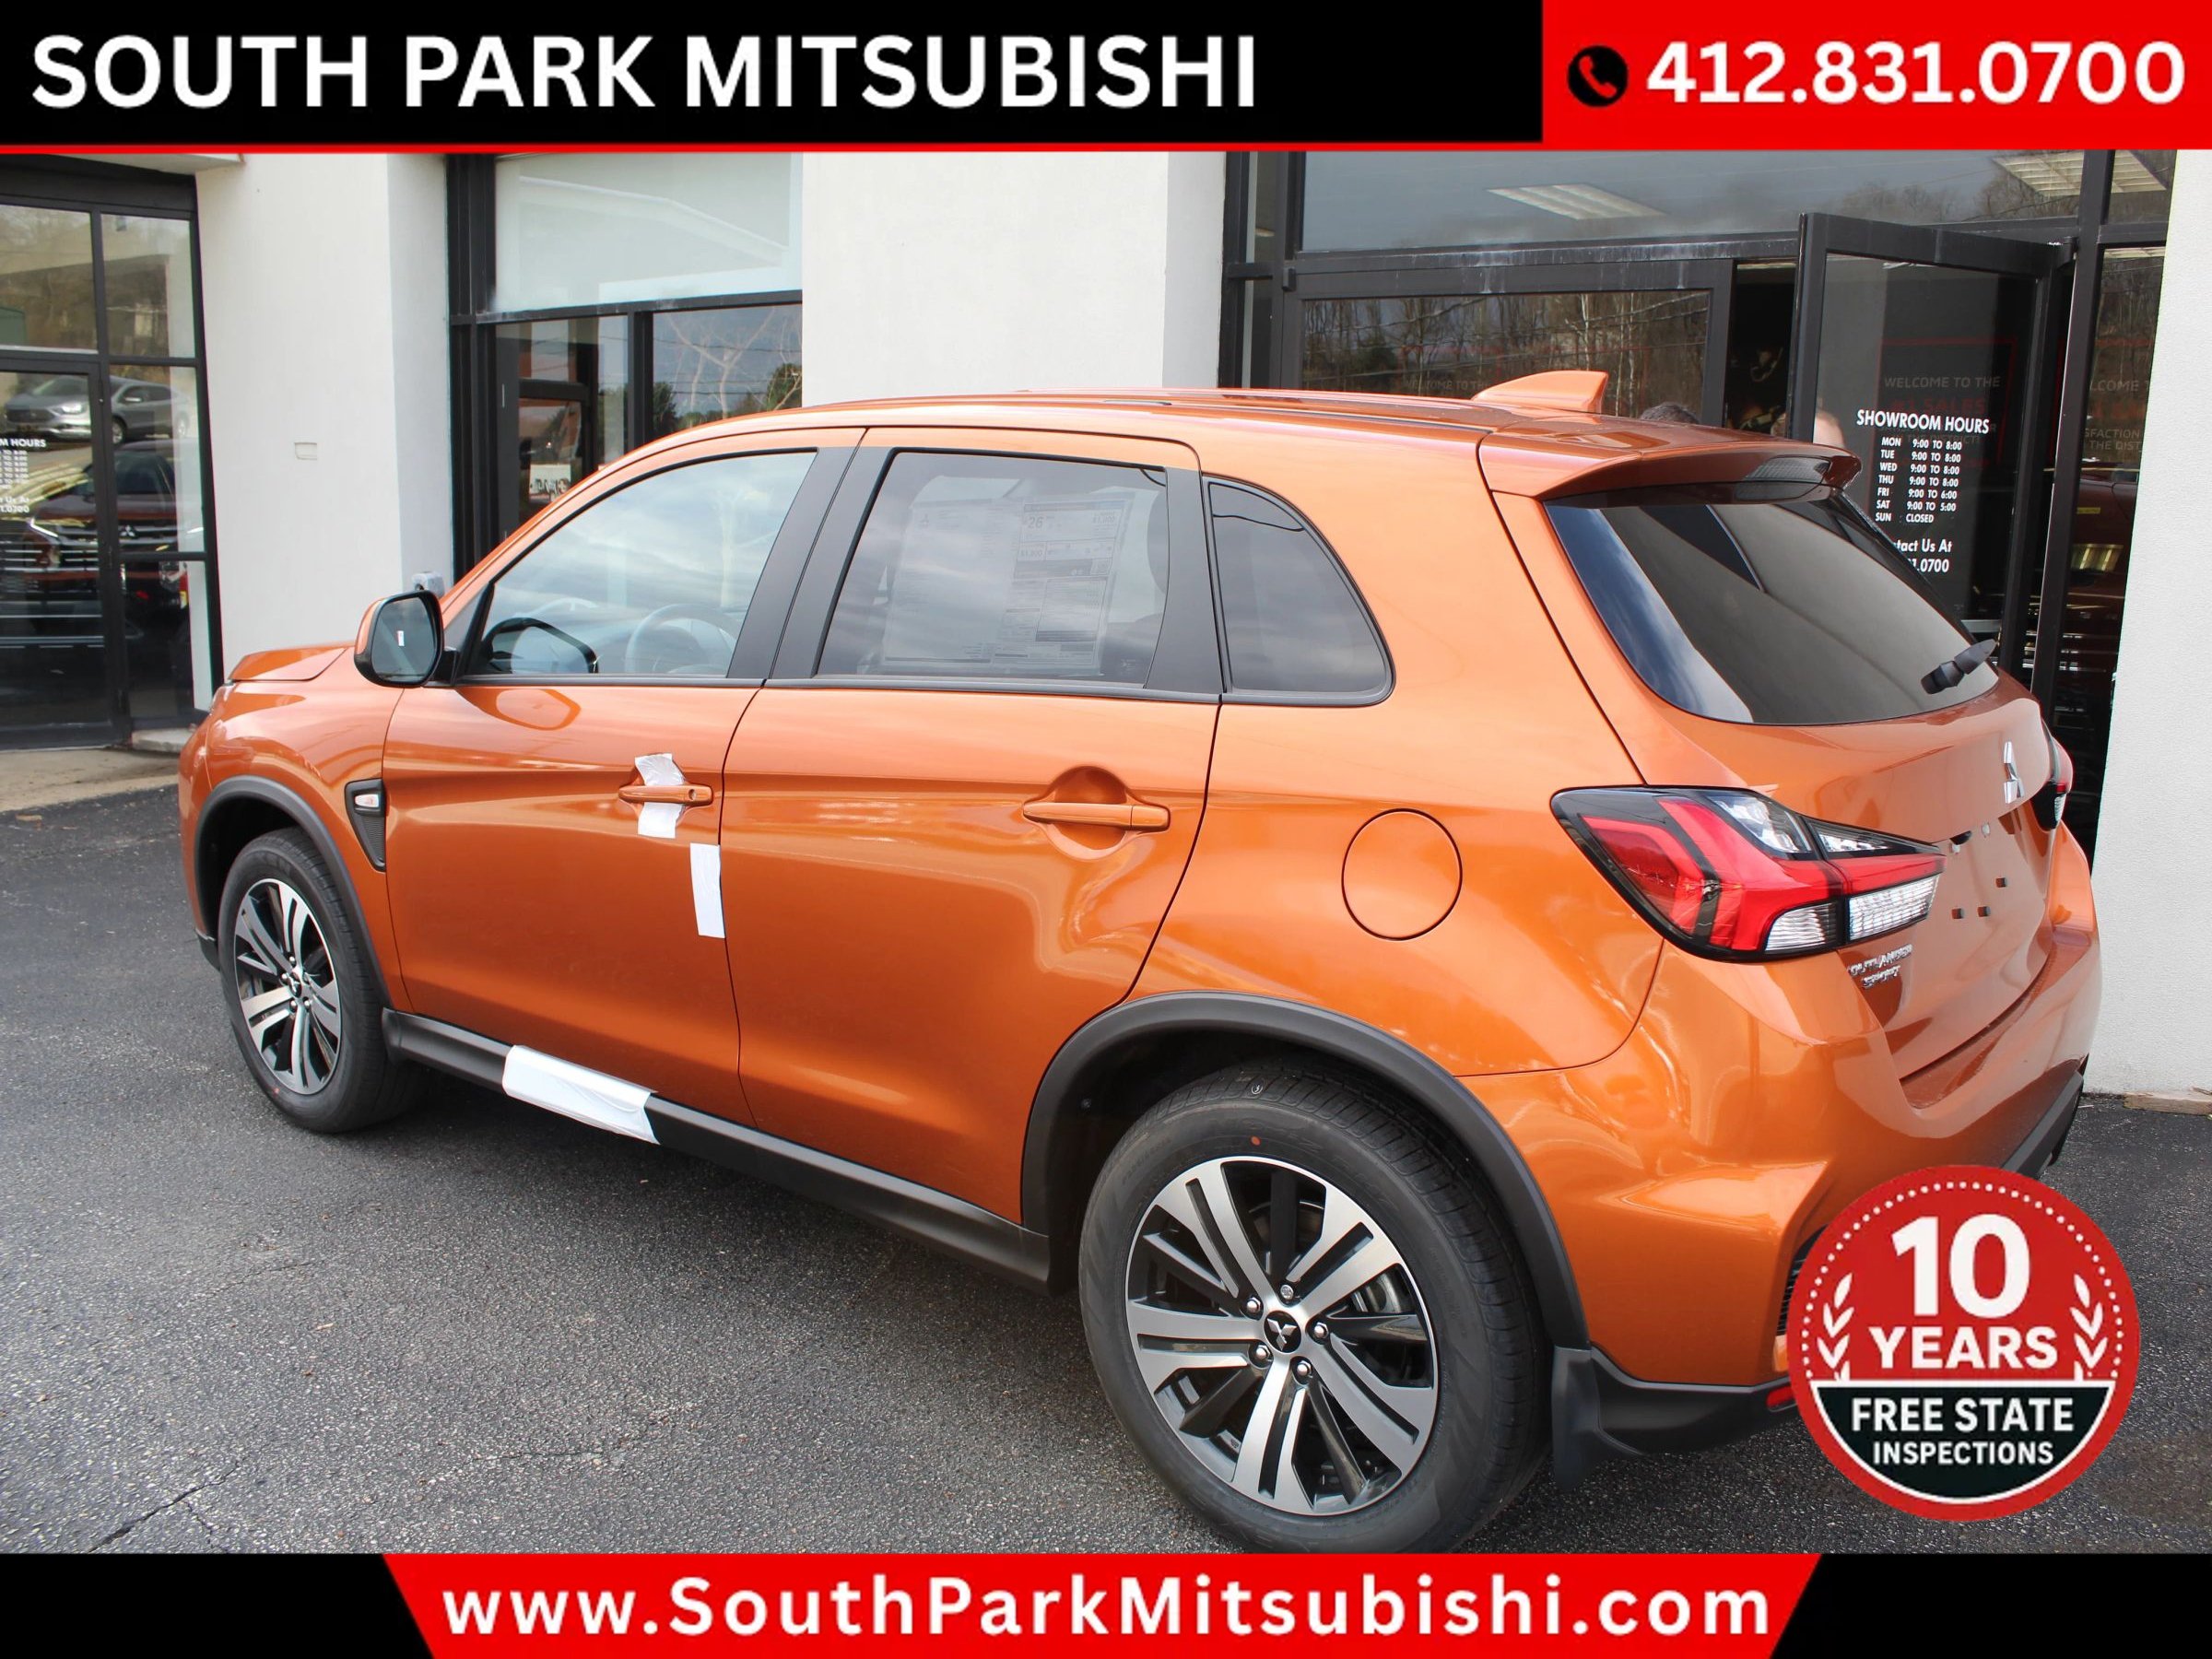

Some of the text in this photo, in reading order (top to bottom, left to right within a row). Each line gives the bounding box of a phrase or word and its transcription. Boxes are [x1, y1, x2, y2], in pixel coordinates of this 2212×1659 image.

[1883, 376, 2001, 388] WELCOME TO THE
[1856, 408, 1941, 431] SHOWROOM
[1945, 416, 1990, 434] HOURS
[10, 438, 47, 448] HOURS
[1881, 437, 1962, 451] MON 9:00 TO 8:00
[1881, 450, 1961, 463] TUE 9:00 TO 8:00
[1879, 462, 1898, 472] WED
[1910, 464, 1926, 474] 9:00
[1930, 465, 1940, 474] TO
[1943, 465, 1959, 476] 8:00
[1878, 475, 1959, 488] THU 9:00 TO 8:00
[1877, 487, 1958, 500] FRI 9:00 TO 6:00
[1876, 500, 1957, 512] SAT 9:00 TO 5:00
[1875, 512, 1935, 524] SUN CLOSED
[1921, 538, 1936, 553] Us
[1938, 538, 1953, 553] At
